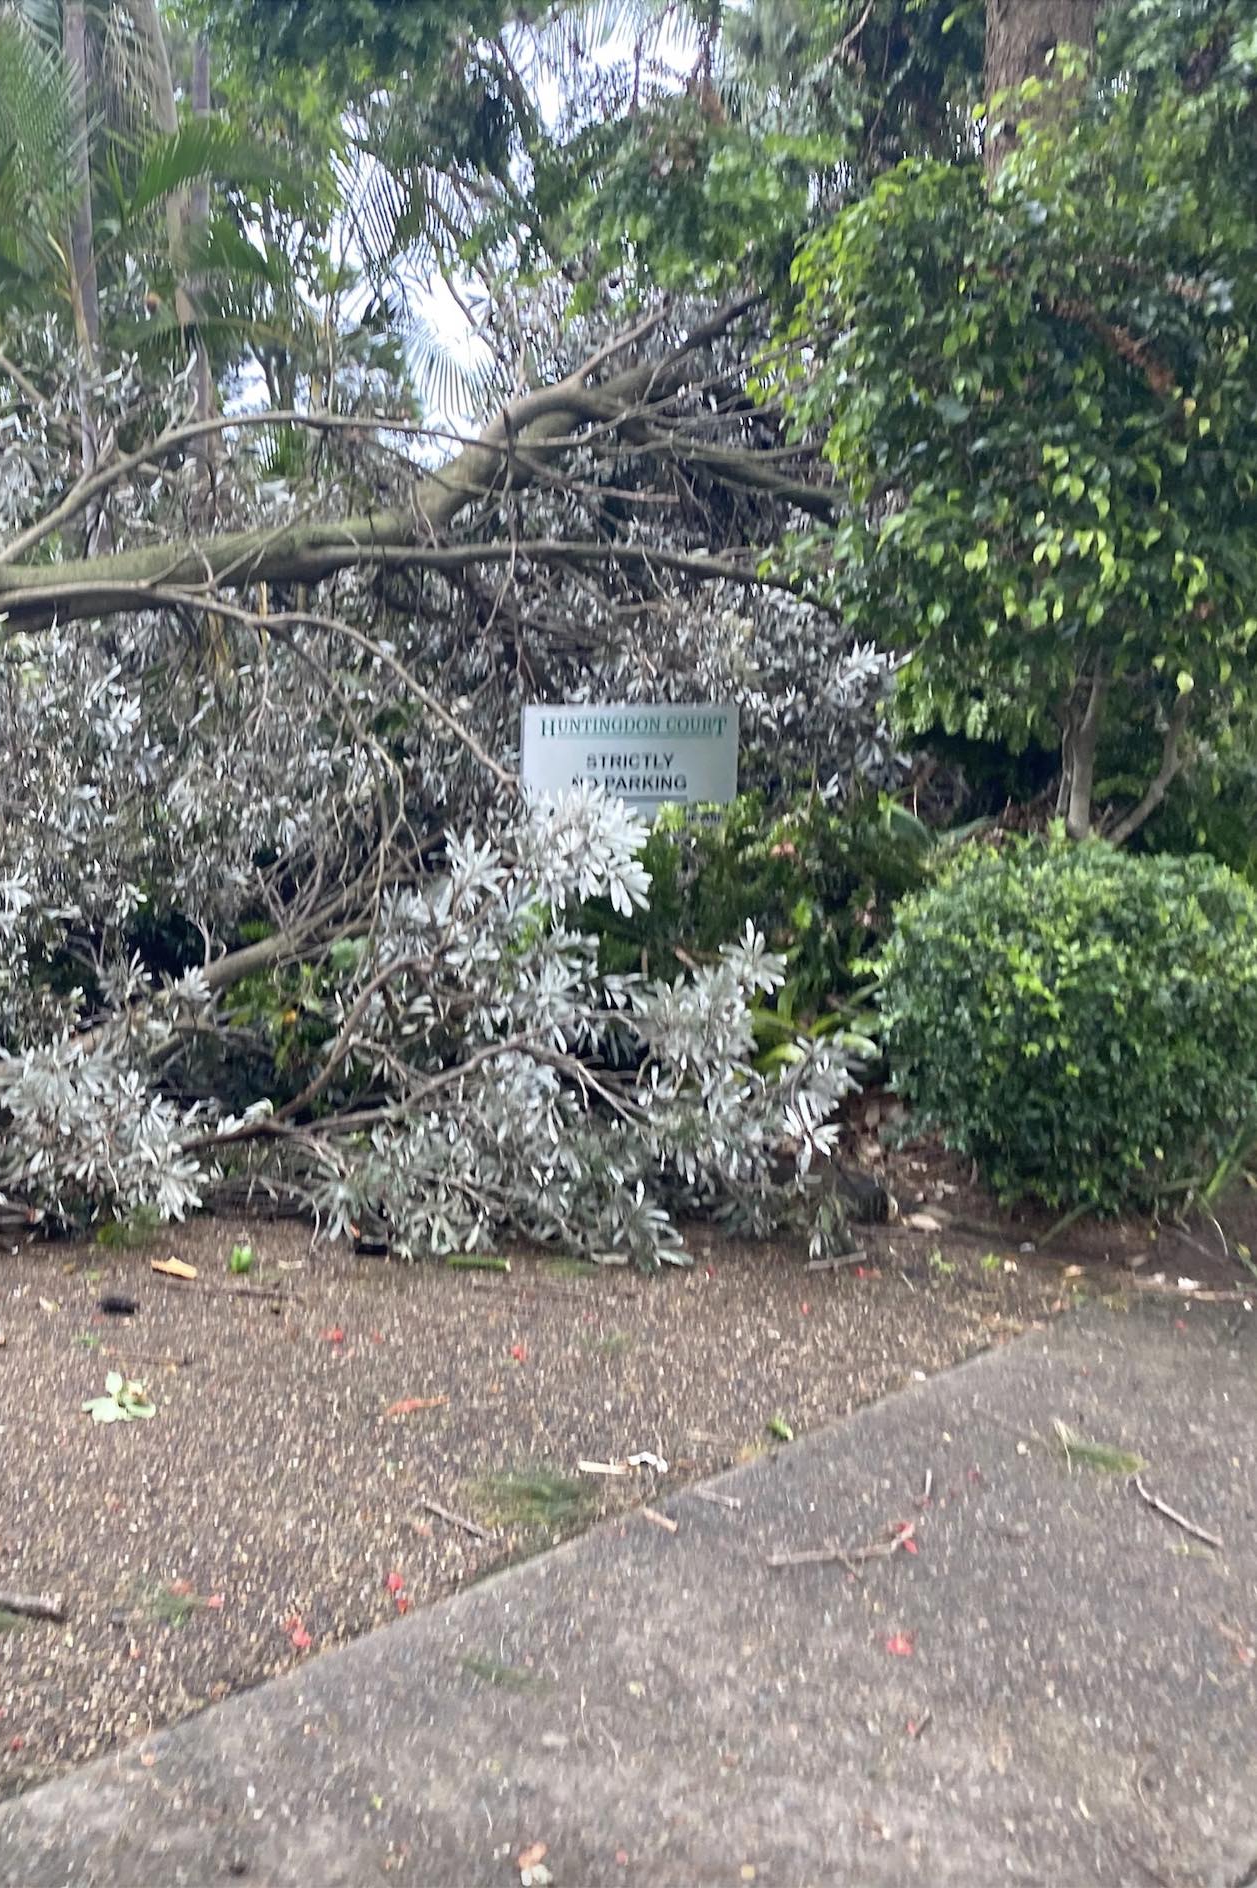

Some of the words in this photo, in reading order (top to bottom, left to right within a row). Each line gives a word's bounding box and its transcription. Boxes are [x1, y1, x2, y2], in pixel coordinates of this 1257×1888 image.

[541, 715, 660, 737] HUNTINGDON
[666, 715, 727, 737] COURT
[586, 752, 674, 770] STRICTLY
[604, 774, 688, 792] PARKING
